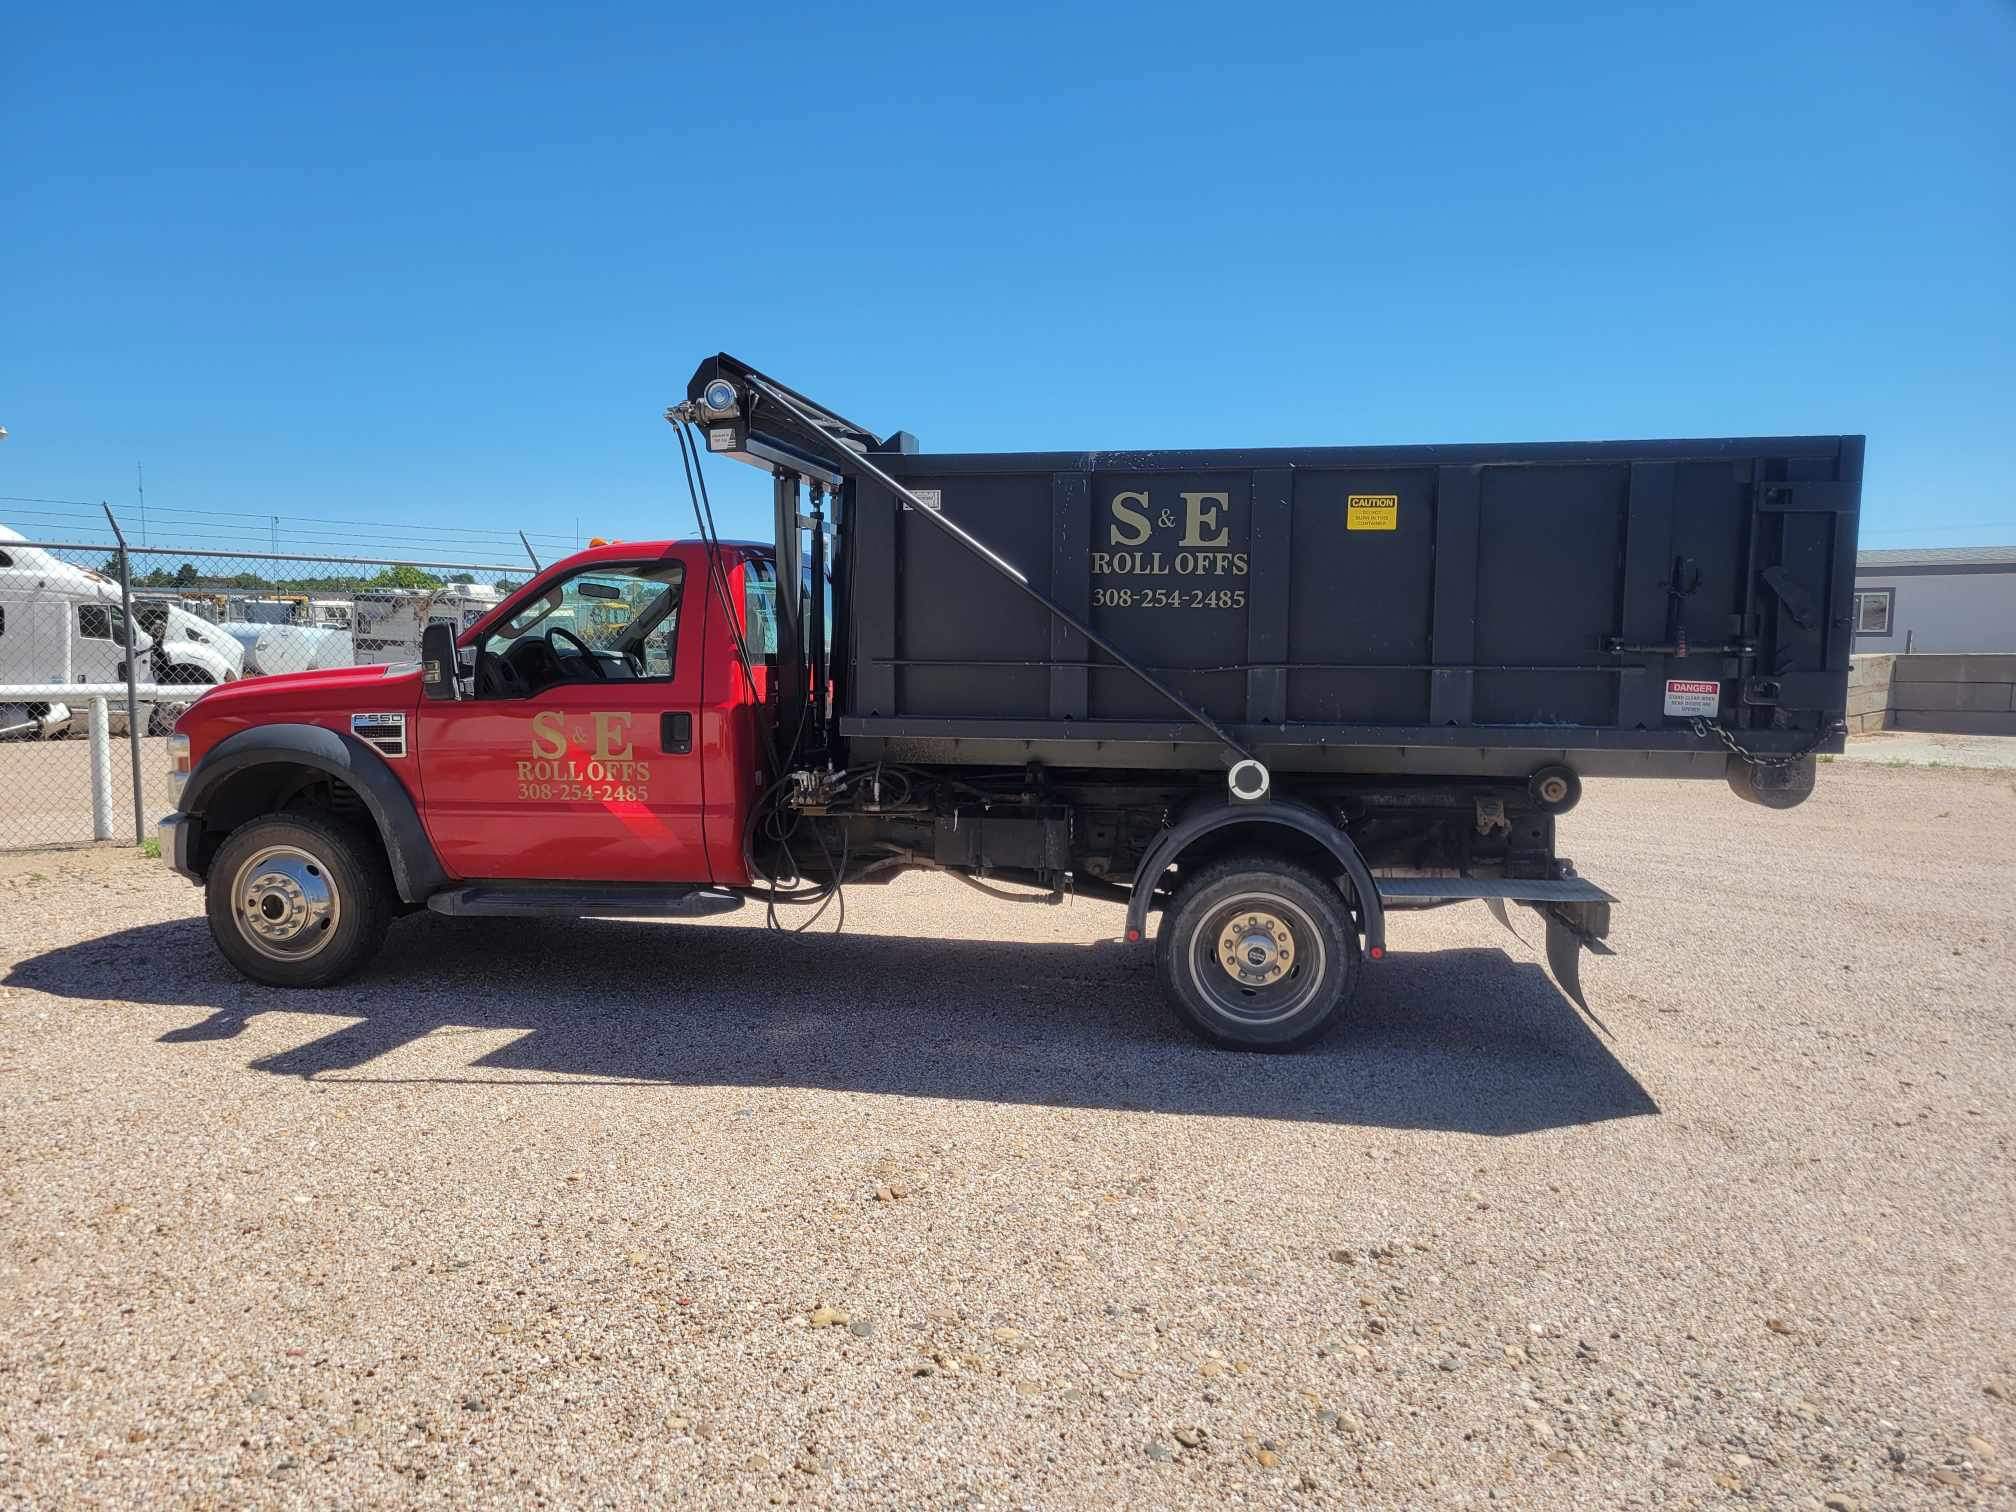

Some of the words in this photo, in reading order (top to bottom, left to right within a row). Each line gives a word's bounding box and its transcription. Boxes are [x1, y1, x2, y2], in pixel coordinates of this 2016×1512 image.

[1352, 498, 1394, 507] CAUTION
[1091, 552, 1169, 574] ROLL
[1174, 552, 1248, 575] OFFS
[1093, 588, 1245, 609] 308-254-2485
[1673, 682, 1713, 693] DANGER
[516, 761, 584, 781] ROLL
[587, 761, 651, 781] OFFS
[518, 783, 649, 801] 308-254-2485
